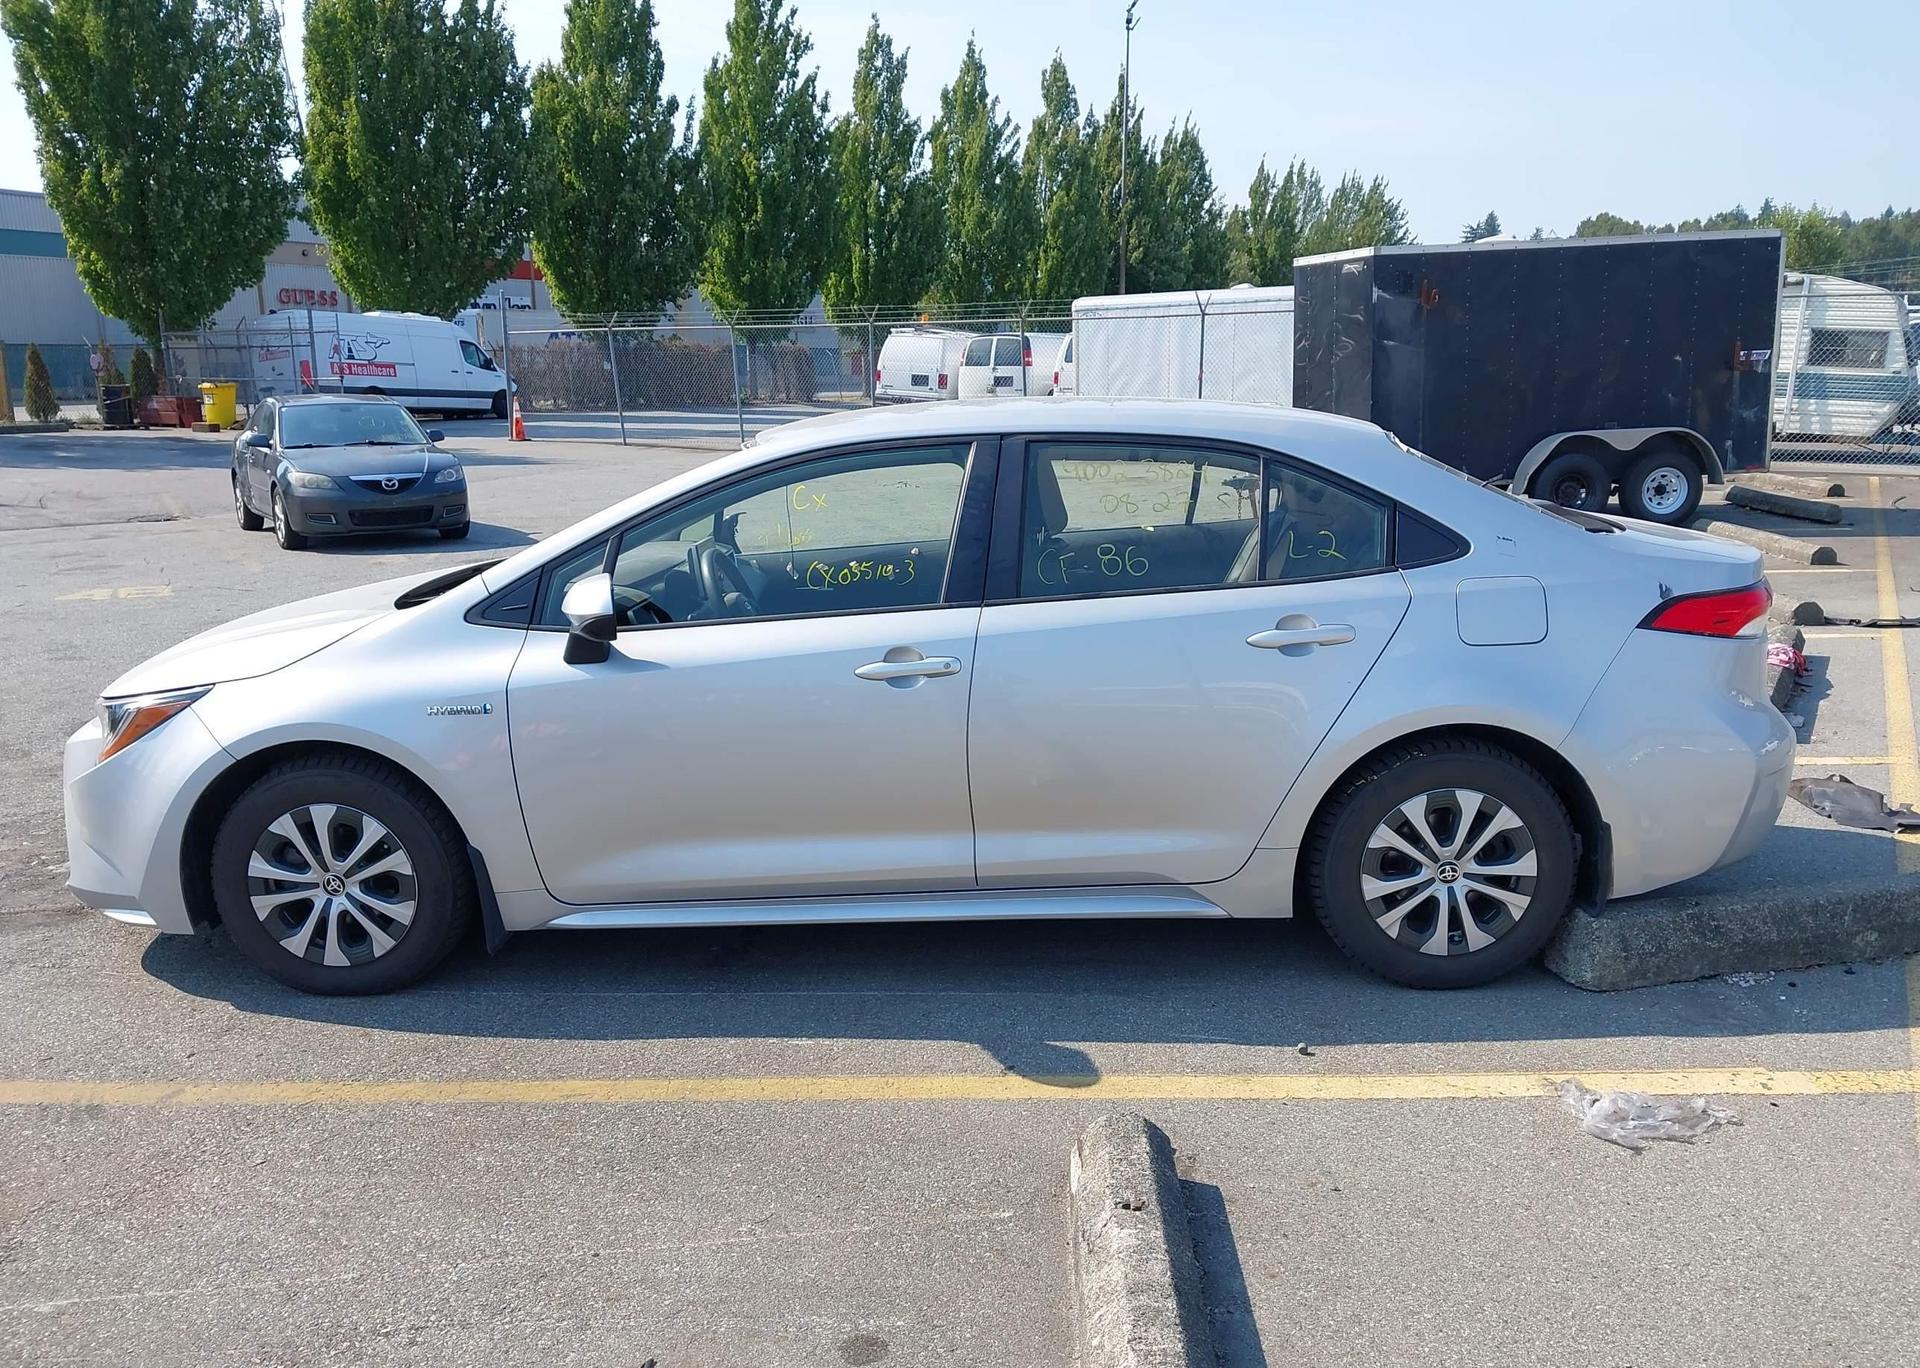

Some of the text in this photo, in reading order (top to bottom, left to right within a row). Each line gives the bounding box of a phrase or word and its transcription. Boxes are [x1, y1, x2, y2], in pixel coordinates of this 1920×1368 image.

[278, 288, 338, 306] GUESS
[333, 363, 395, 377] AS Healthcare
[1288, 530, 1346, 560] L-2
[427, 705, 482, 716] HYBRID
